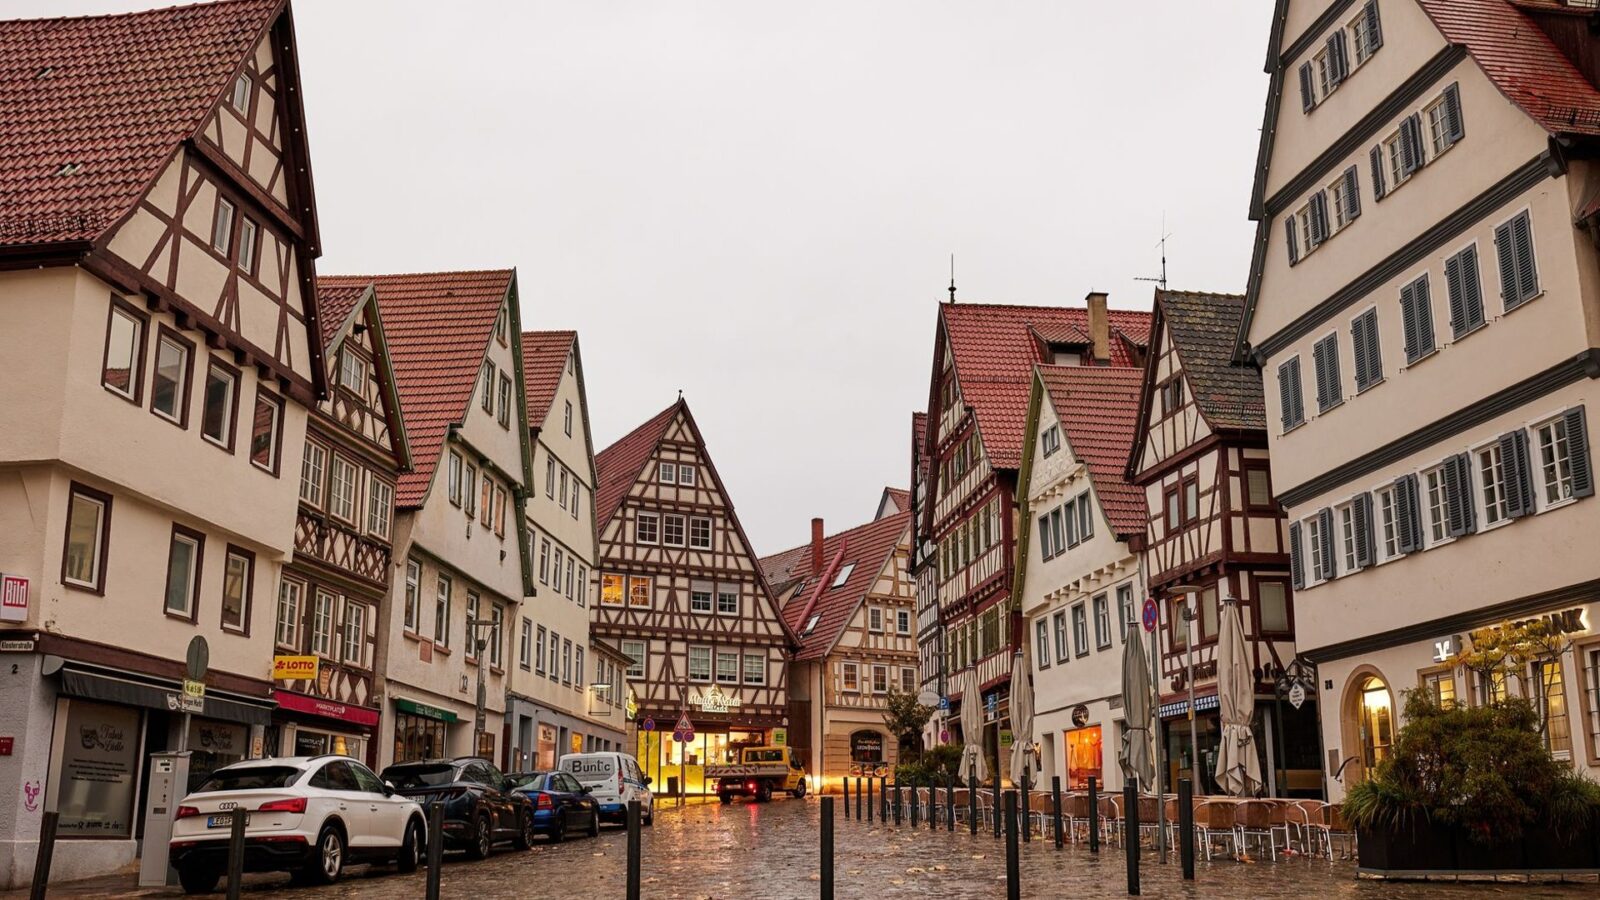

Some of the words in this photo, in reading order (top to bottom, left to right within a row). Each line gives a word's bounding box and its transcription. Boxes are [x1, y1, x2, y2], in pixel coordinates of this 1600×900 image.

[5, 580, 27, 605] Bild
[1, 641, 33, 650] Klosterstraße
[11, 663, 19, 674] 2
[286, 661, 315, 670] LOTTO
